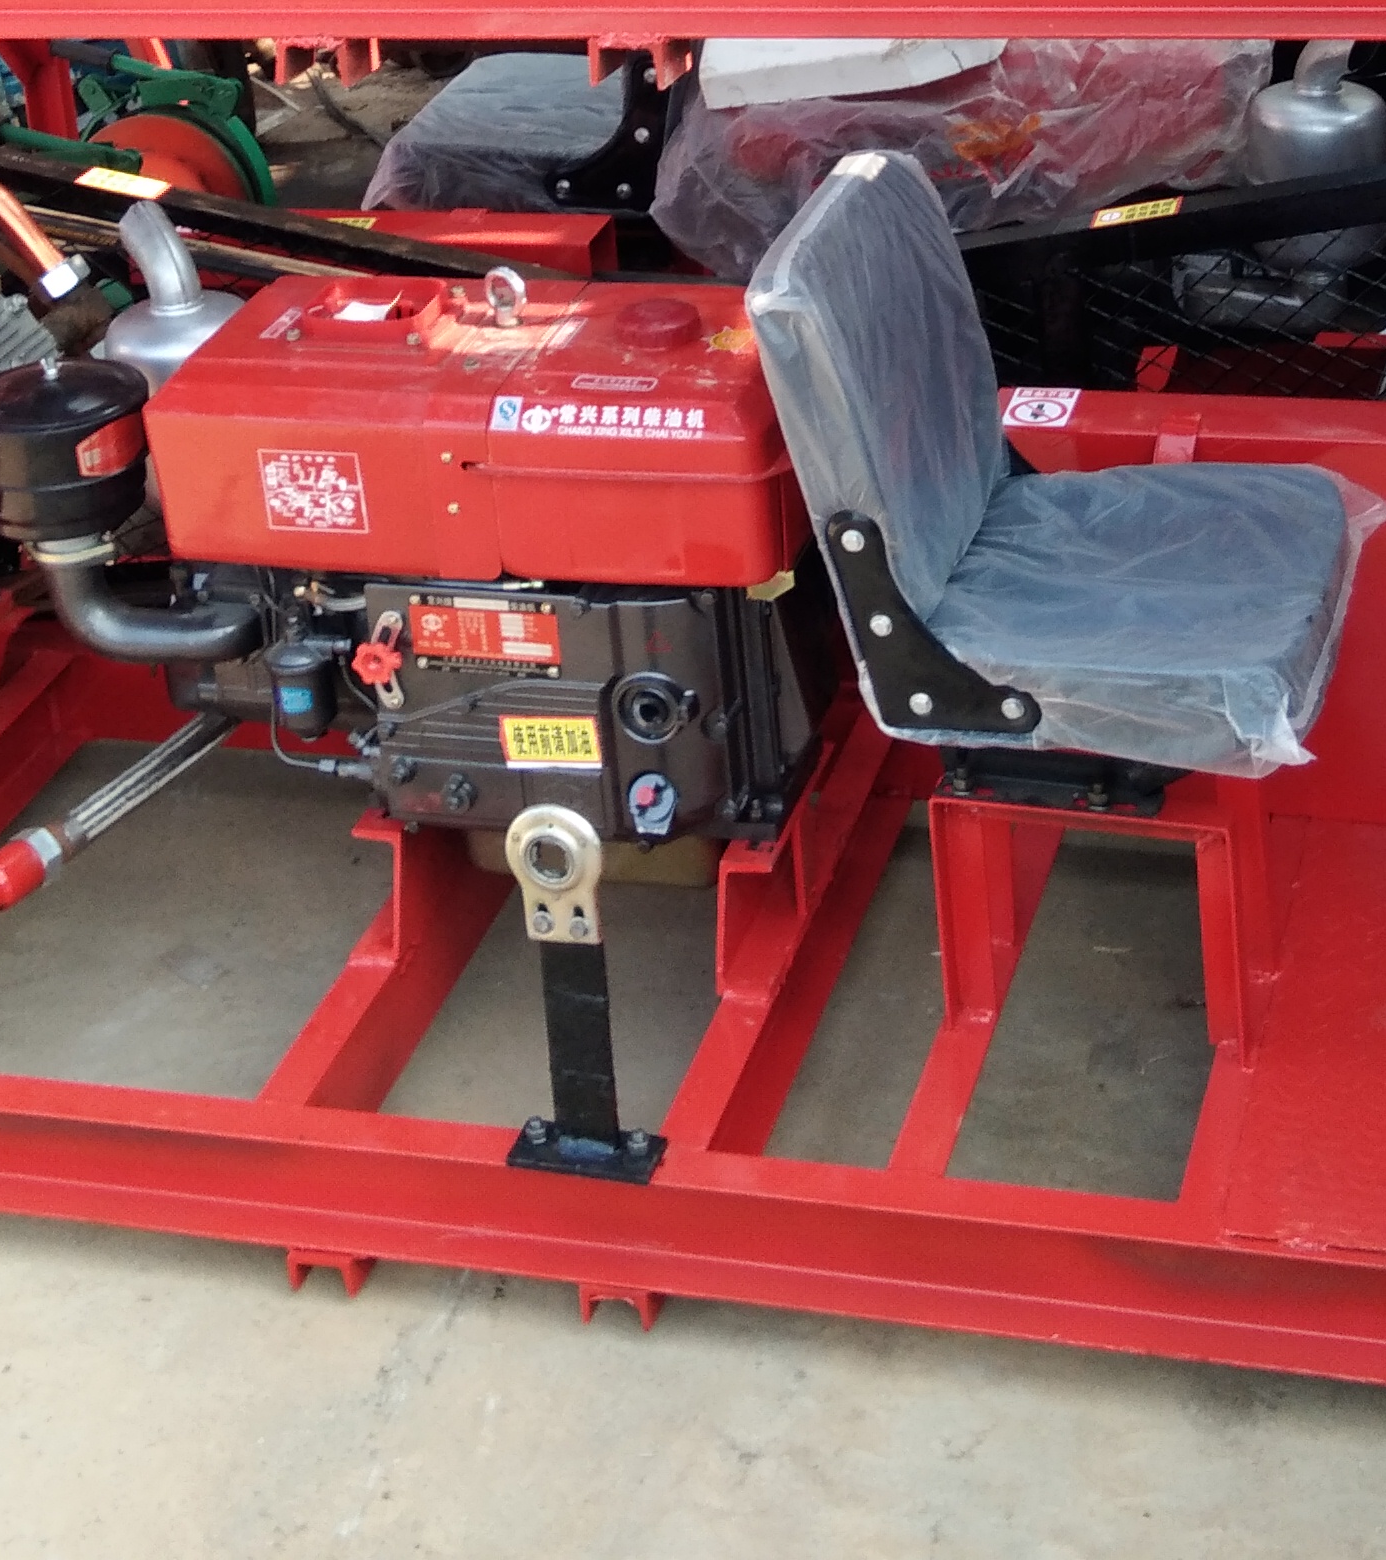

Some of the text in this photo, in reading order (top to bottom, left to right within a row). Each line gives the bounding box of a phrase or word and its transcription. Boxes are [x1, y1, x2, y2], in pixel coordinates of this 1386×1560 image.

[559, 404, 704, 429] 常兴系列柴油机
[557, 425, 592, 436] CHANG
[593, 426, 618, 437] XING
[644, 428, 670, 438] CHAI
[670, 429, 693, 439] YOU
[512, 724, 593, 756] 使用前请加油
